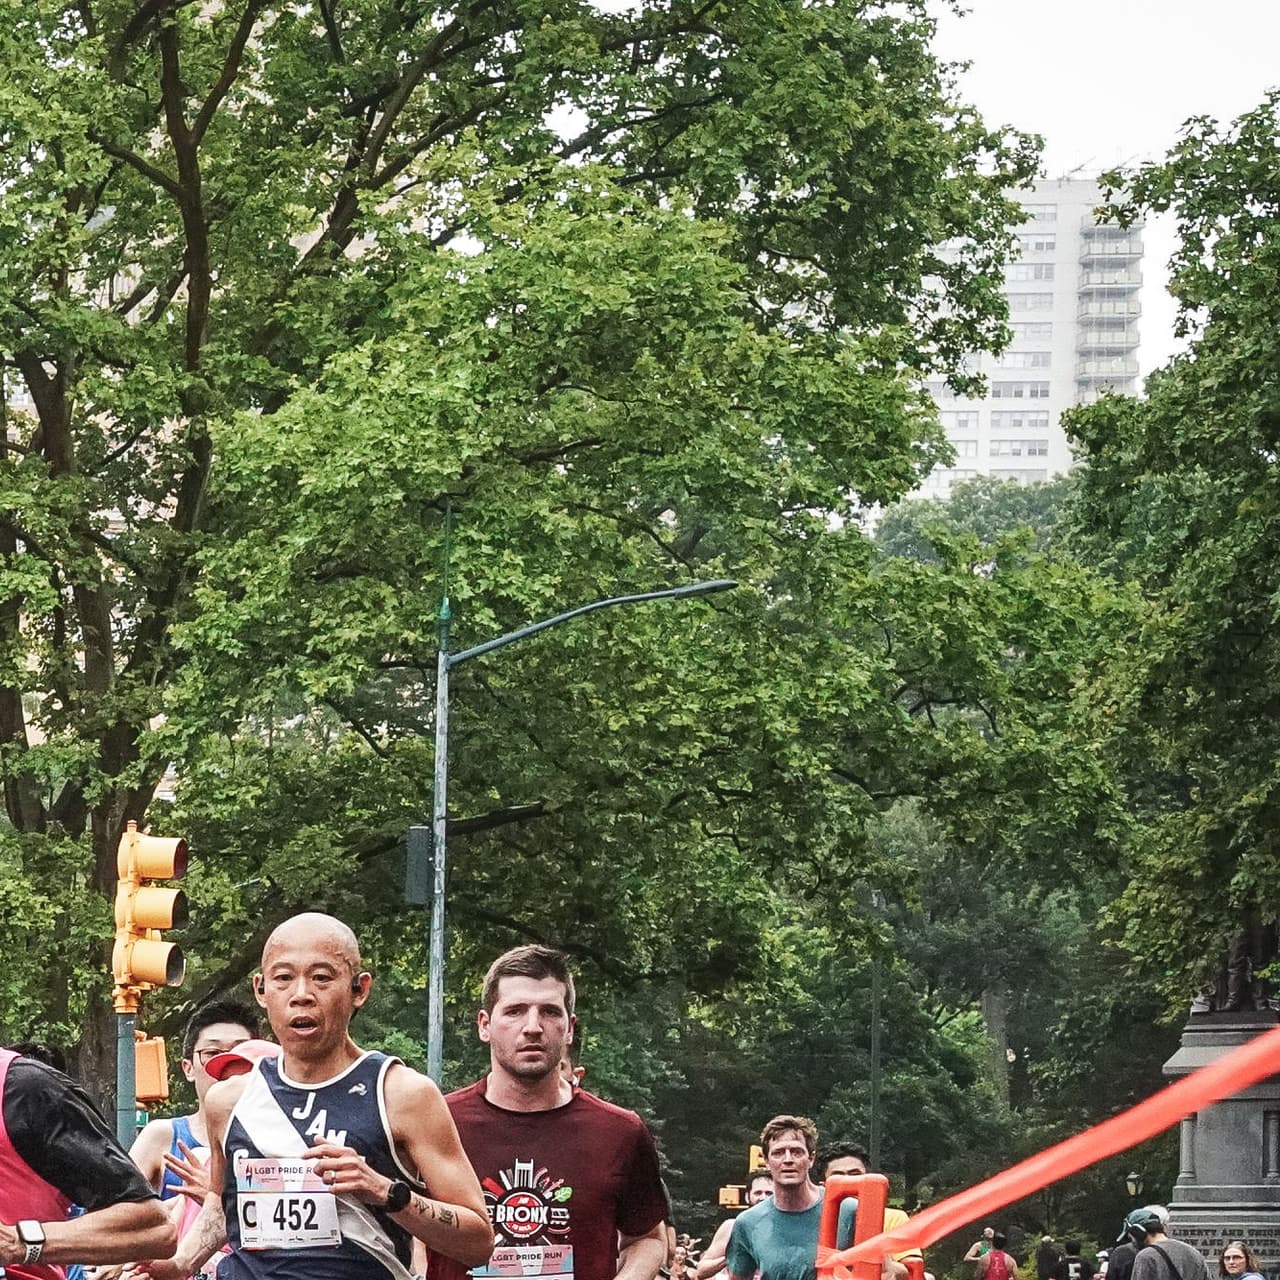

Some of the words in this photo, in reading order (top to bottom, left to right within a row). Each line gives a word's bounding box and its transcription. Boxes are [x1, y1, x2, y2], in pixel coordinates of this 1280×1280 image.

[243, 1201, 257, 1228] C
[273, 1199, 319, 1231] 452
[496, 1204, 549, 1225] BRONX
[492, 1254, 514, 1262] LGBT
[516, 1253, 542, 1261] PRIDE
